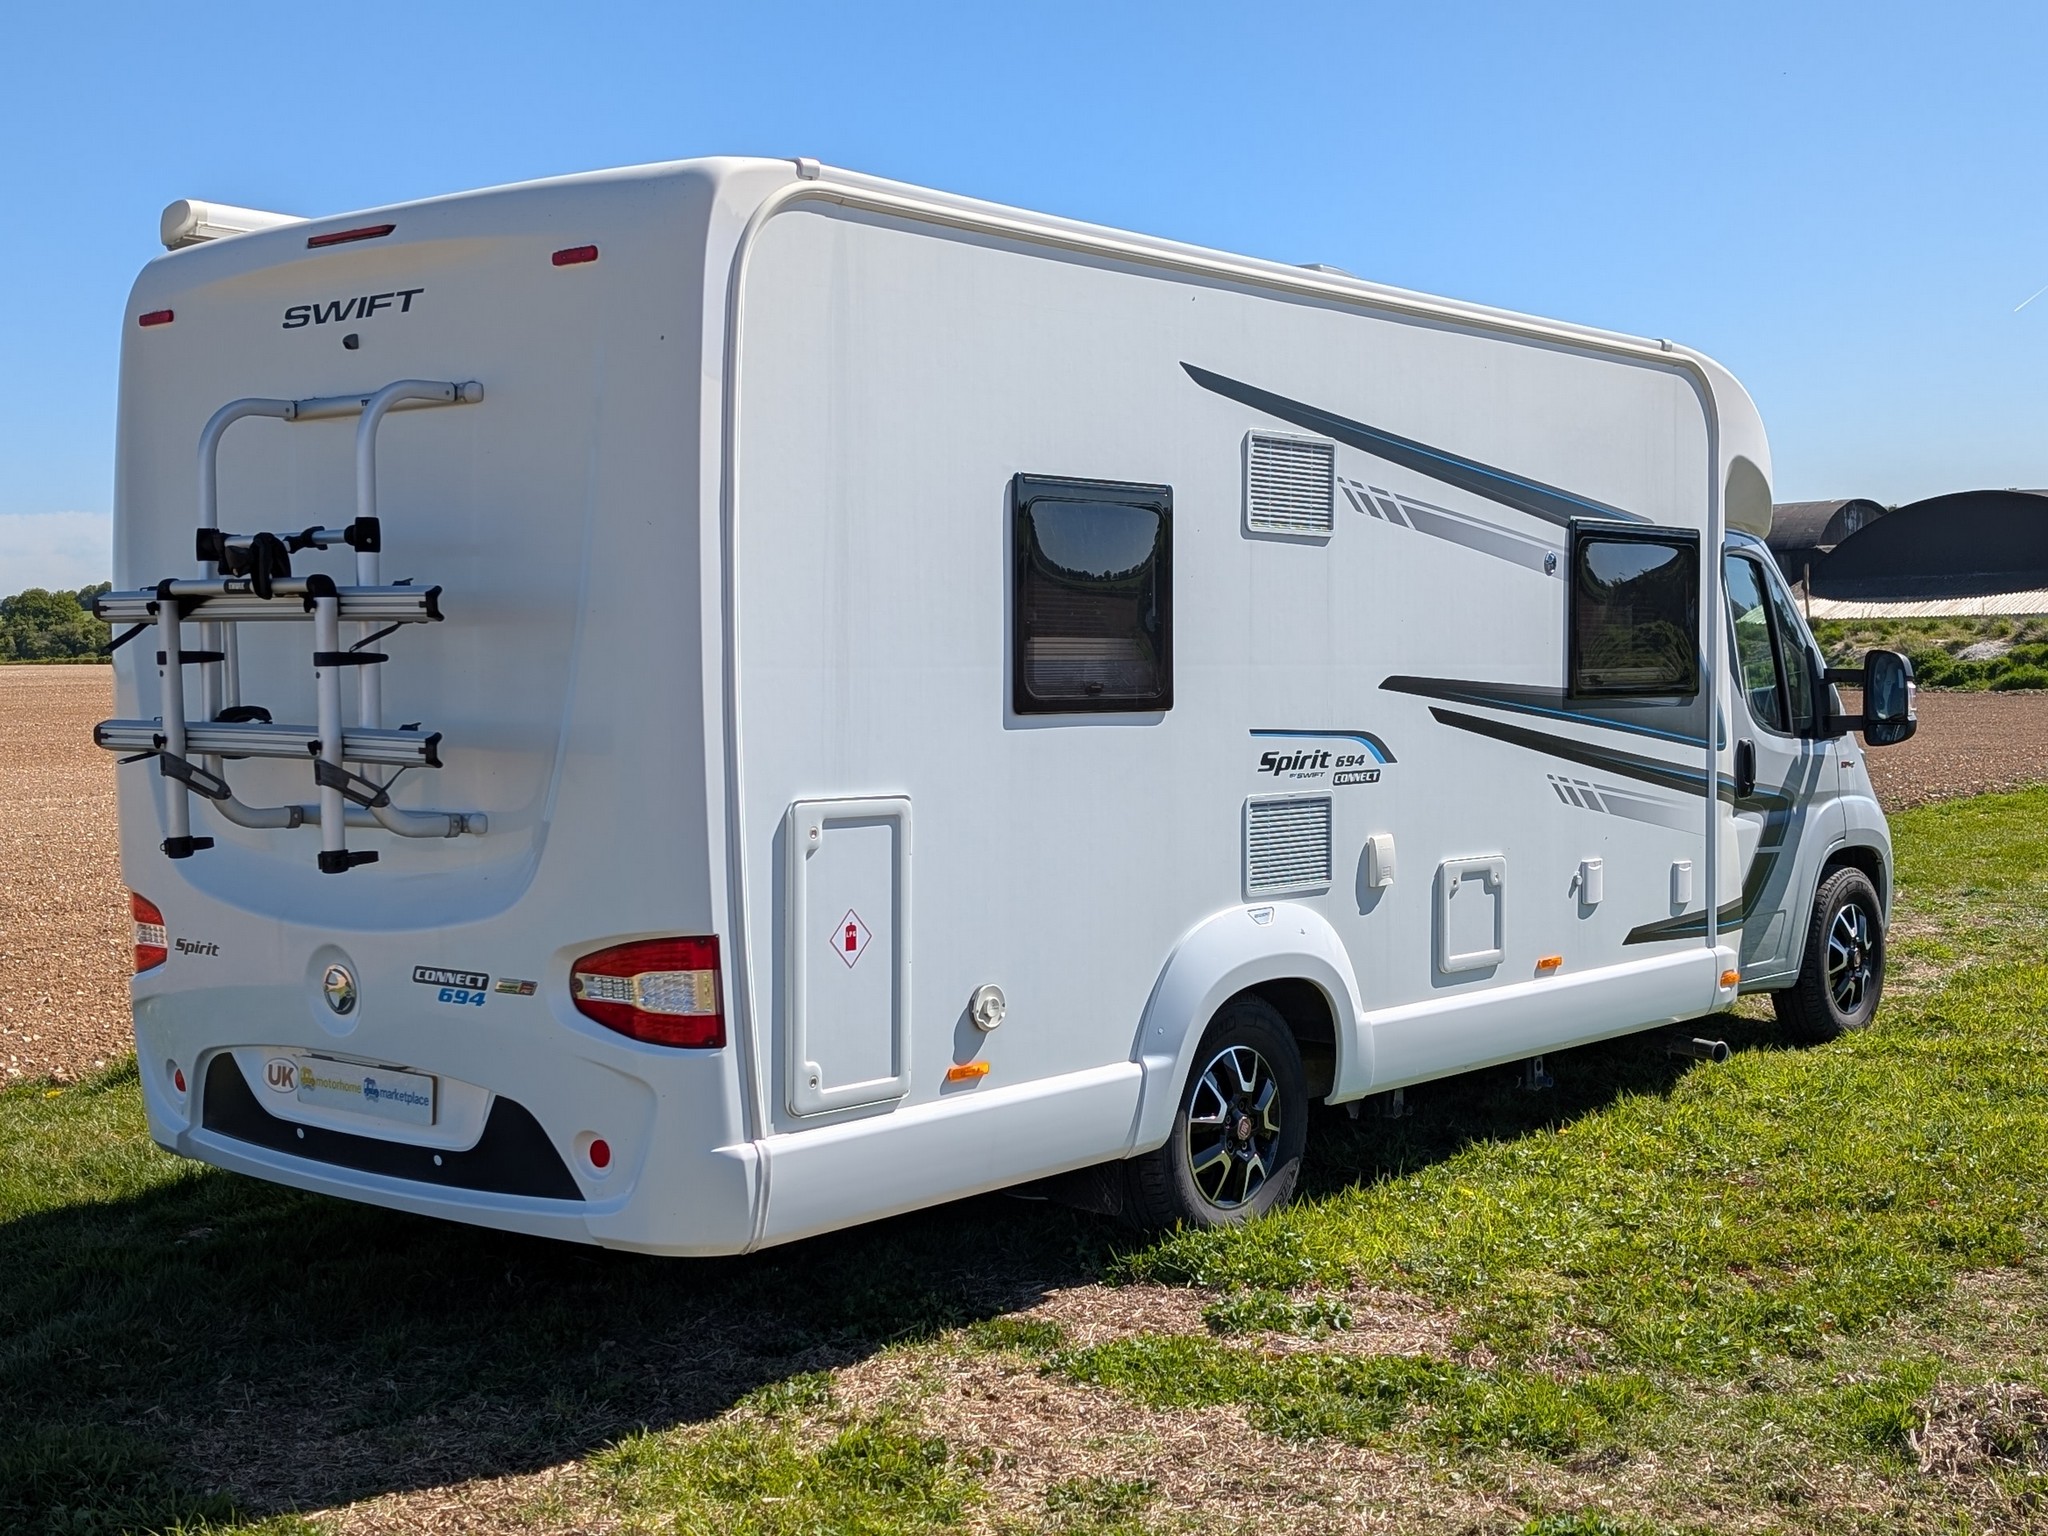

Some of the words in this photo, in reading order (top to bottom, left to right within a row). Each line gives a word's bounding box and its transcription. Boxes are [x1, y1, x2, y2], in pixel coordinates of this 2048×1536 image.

[282, 287, 425, 329] SWIFT
[1257, 749, 1333, 776] Spirit
[1335, 754, 1366, 767] 694
[1297, 771, 1326, 779] SWIFT
[1333, 770, 1380, 784] CONNECT
[846, 930, 857, 938] LPG
[174, 937, 221, 957] Spirit
[414, 968, 488, 988] CONNECT
[438, 988, 487, 1007] 694
[267, 1063, 296, 1089] UK
[315, 1077, 362, 1094] motorhome
[379, 1088, 430, 1106] marketplace
